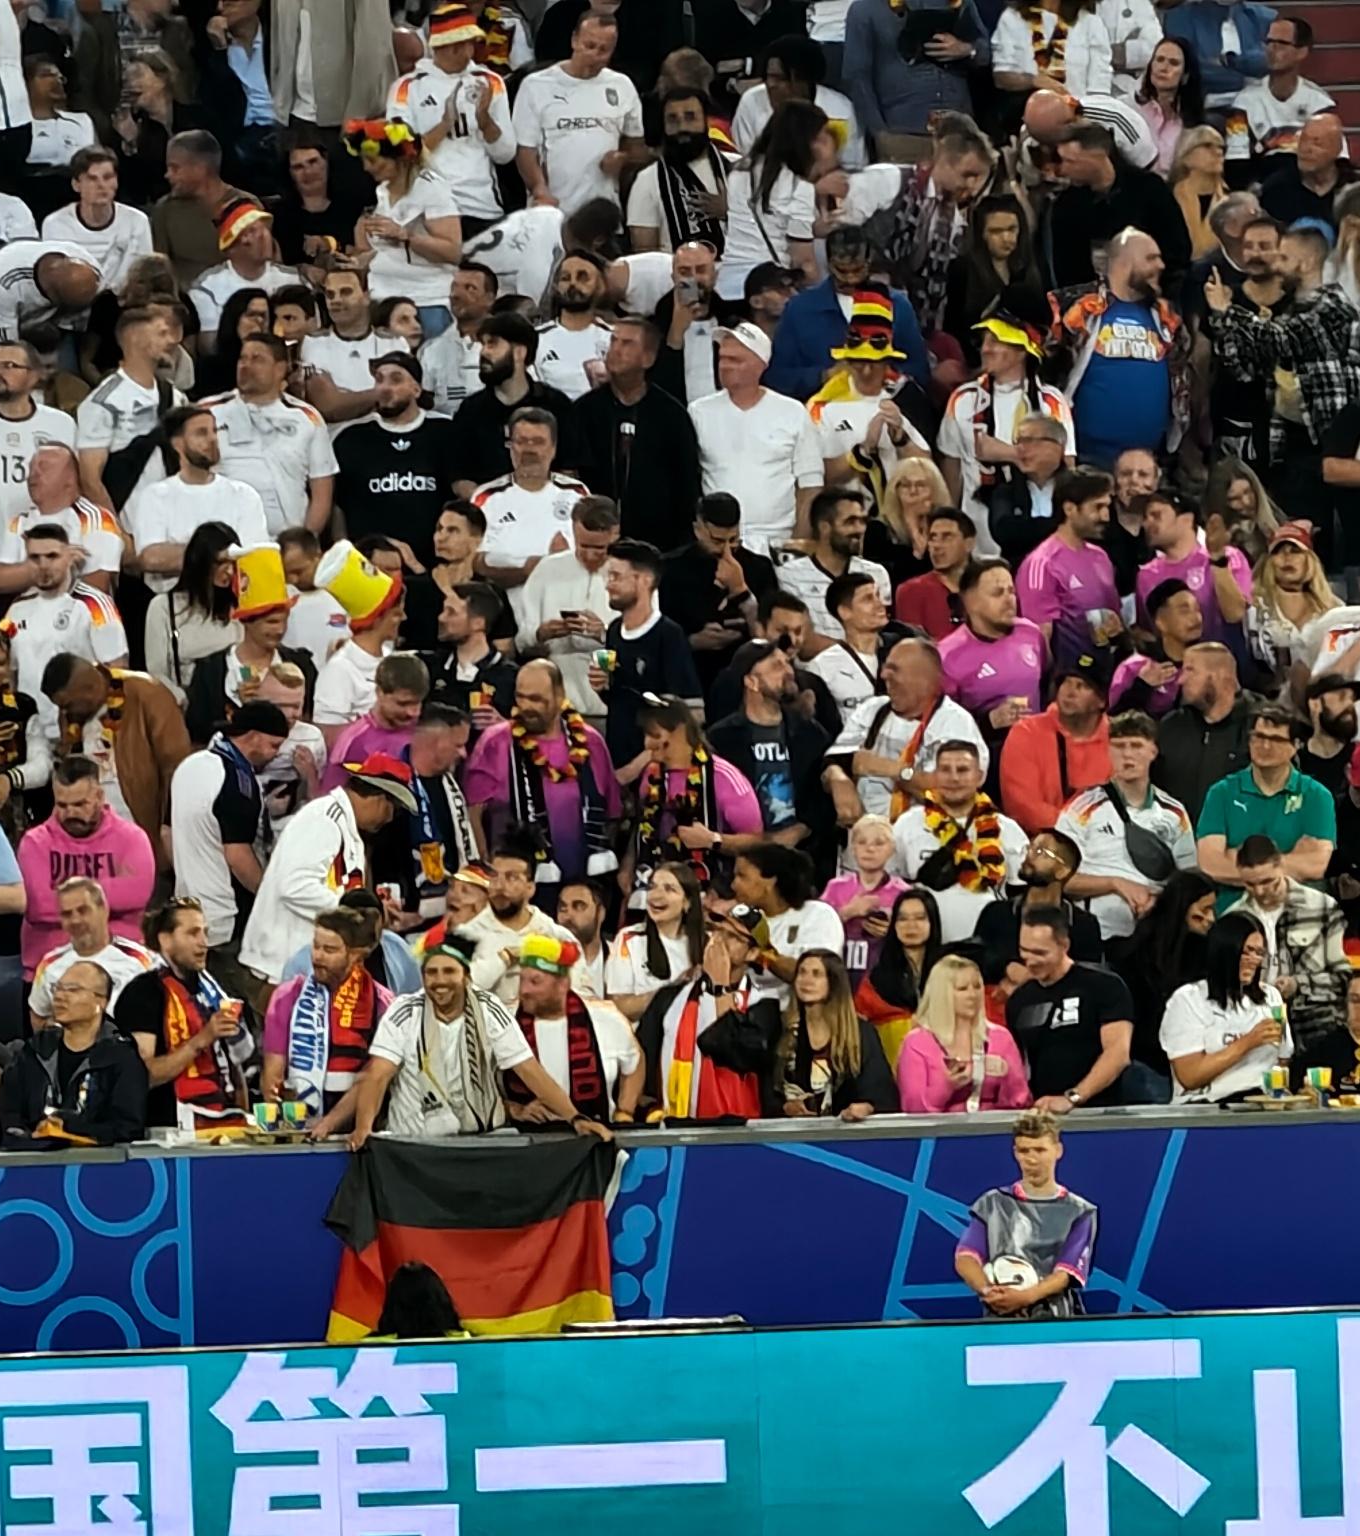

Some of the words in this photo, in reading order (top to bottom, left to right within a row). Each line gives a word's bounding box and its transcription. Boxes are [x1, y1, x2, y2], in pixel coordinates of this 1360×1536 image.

[1, 454, 26, 484] 13
[368, 470, 437, 494] adidas
[846, 940, 869, 970] 10
